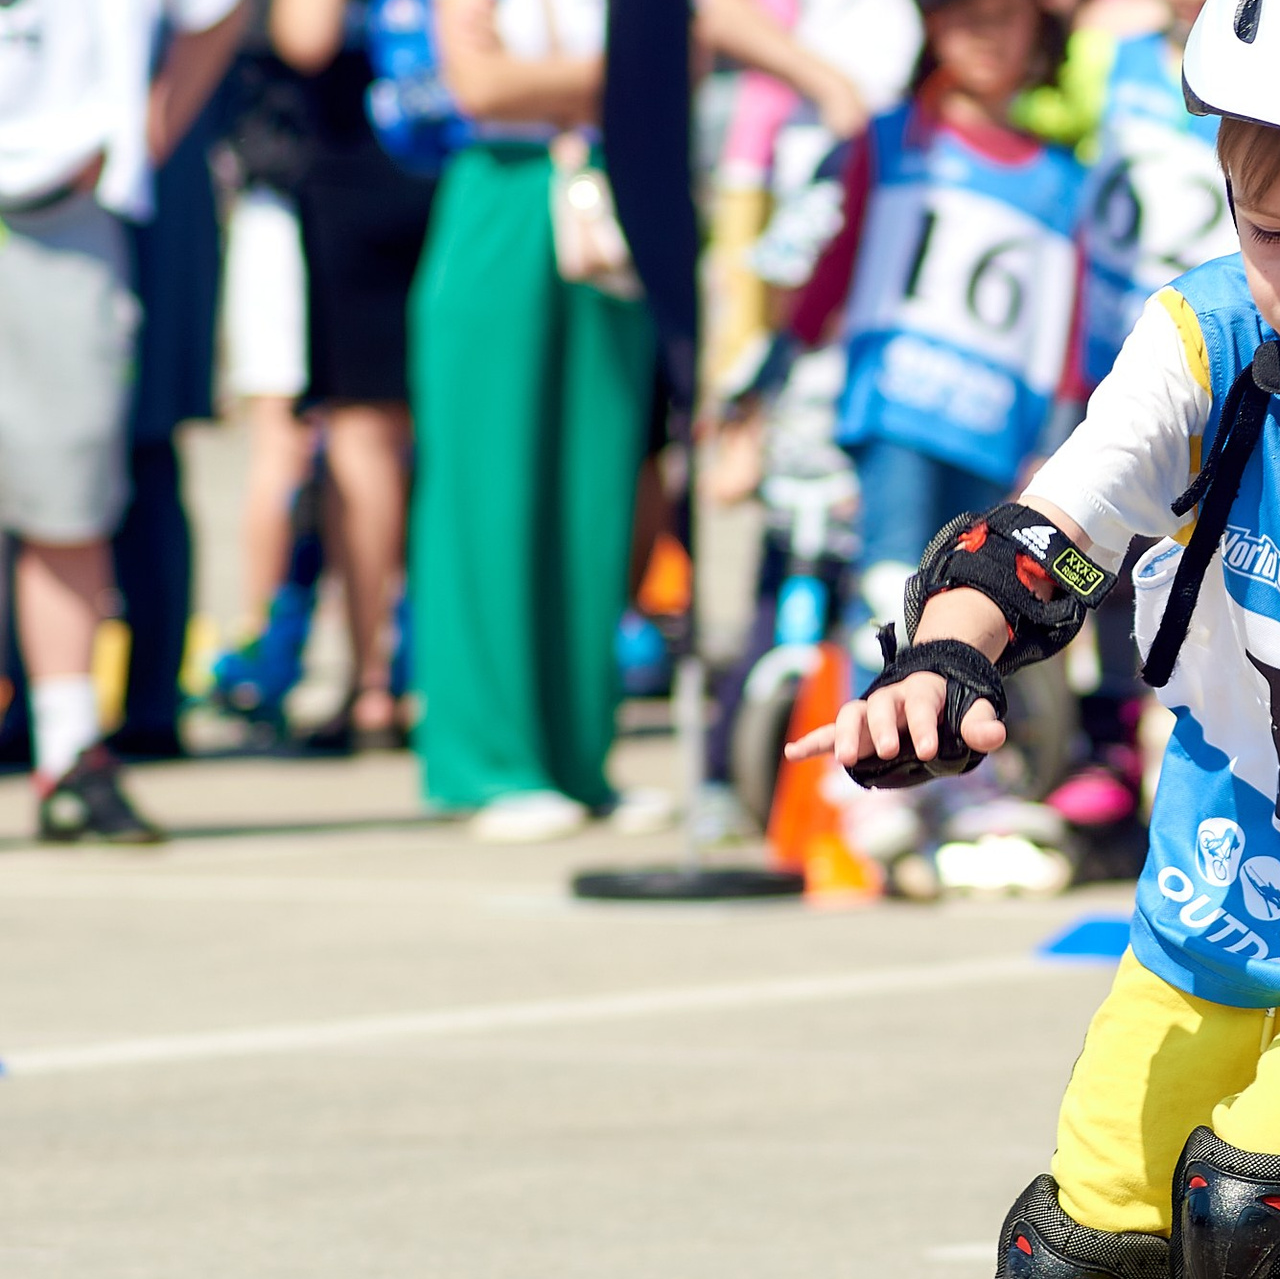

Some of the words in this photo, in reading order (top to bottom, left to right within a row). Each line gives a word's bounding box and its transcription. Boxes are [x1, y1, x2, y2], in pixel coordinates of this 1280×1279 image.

[905, 209, 1024, 335] 16
[1061, 565, 1087, 588] RIGHT
[1066, 553, 1098, 583] XXXS
